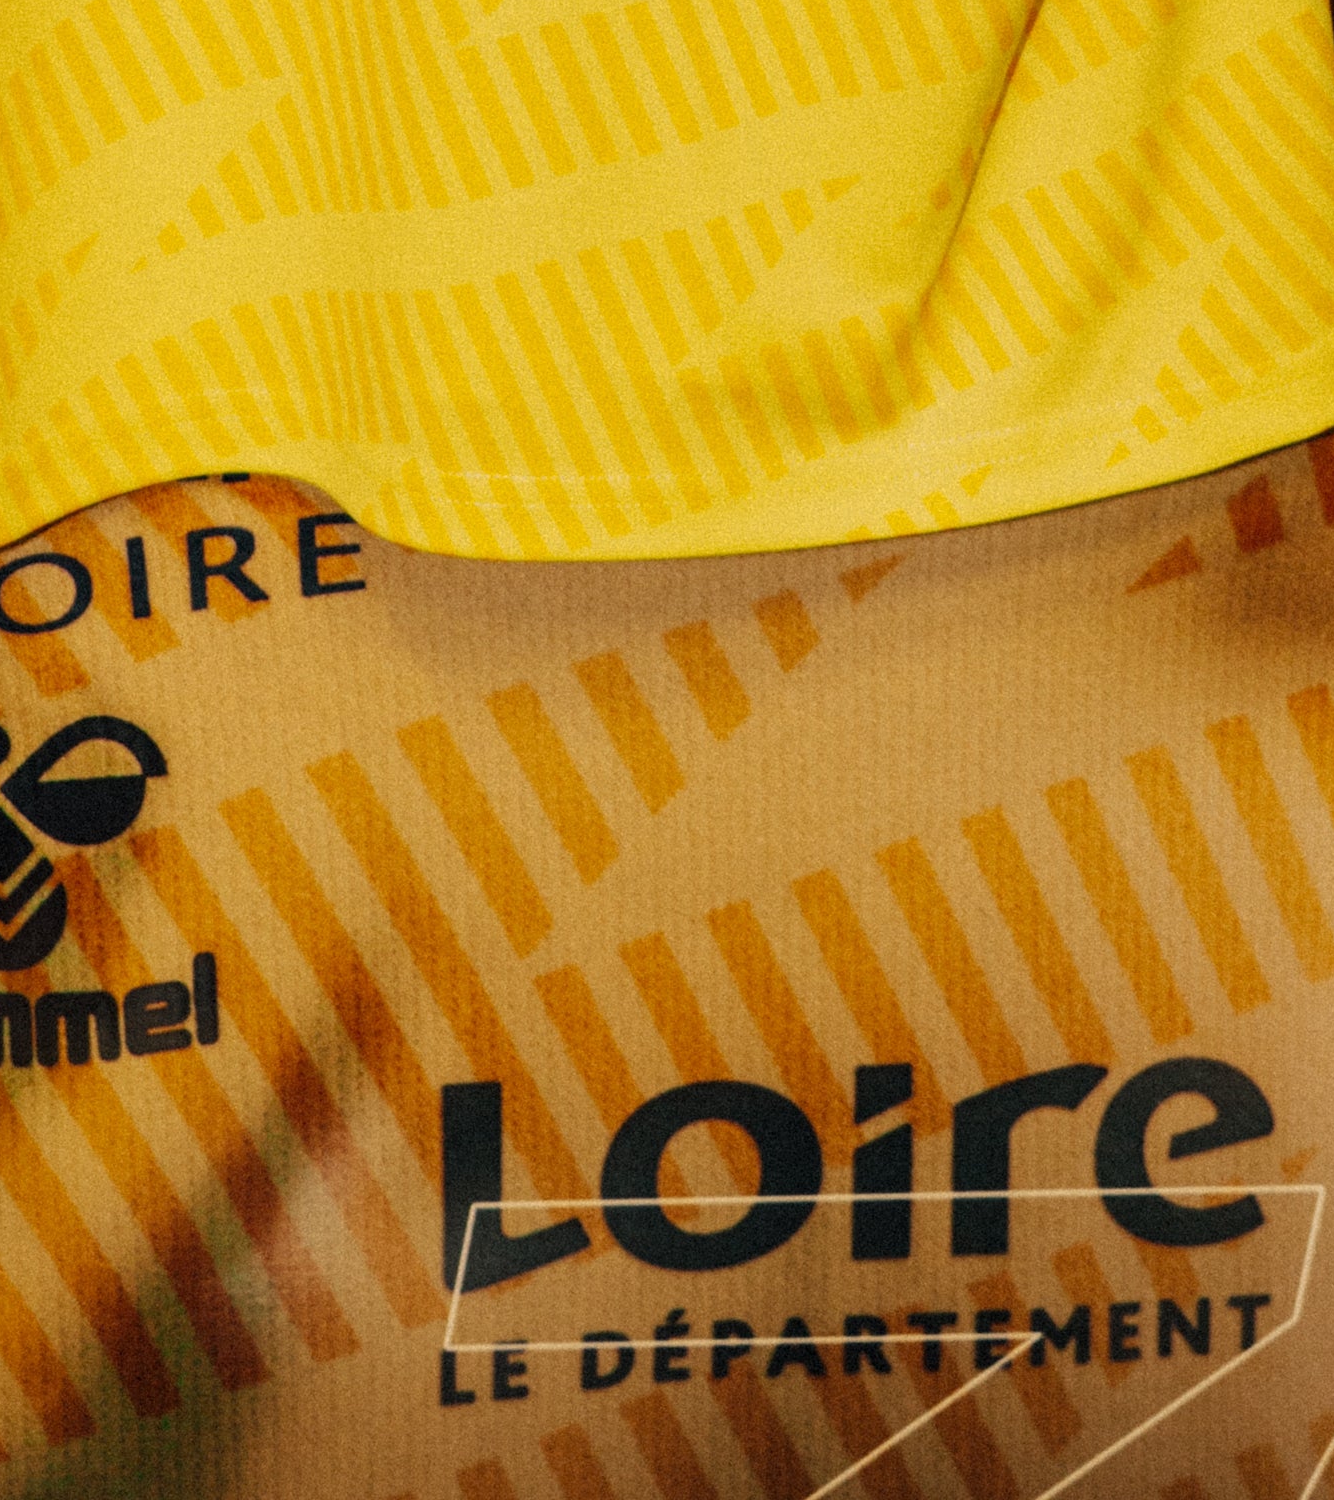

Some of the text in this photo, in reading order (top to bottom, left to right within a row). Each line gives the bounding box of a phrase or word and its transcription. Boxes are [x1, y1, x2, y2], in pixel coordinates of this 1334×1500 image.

[440, 1057, 1275, 1296] Loire
[439, 1293, 1272, 1407] LE DÉPARTEMENT
